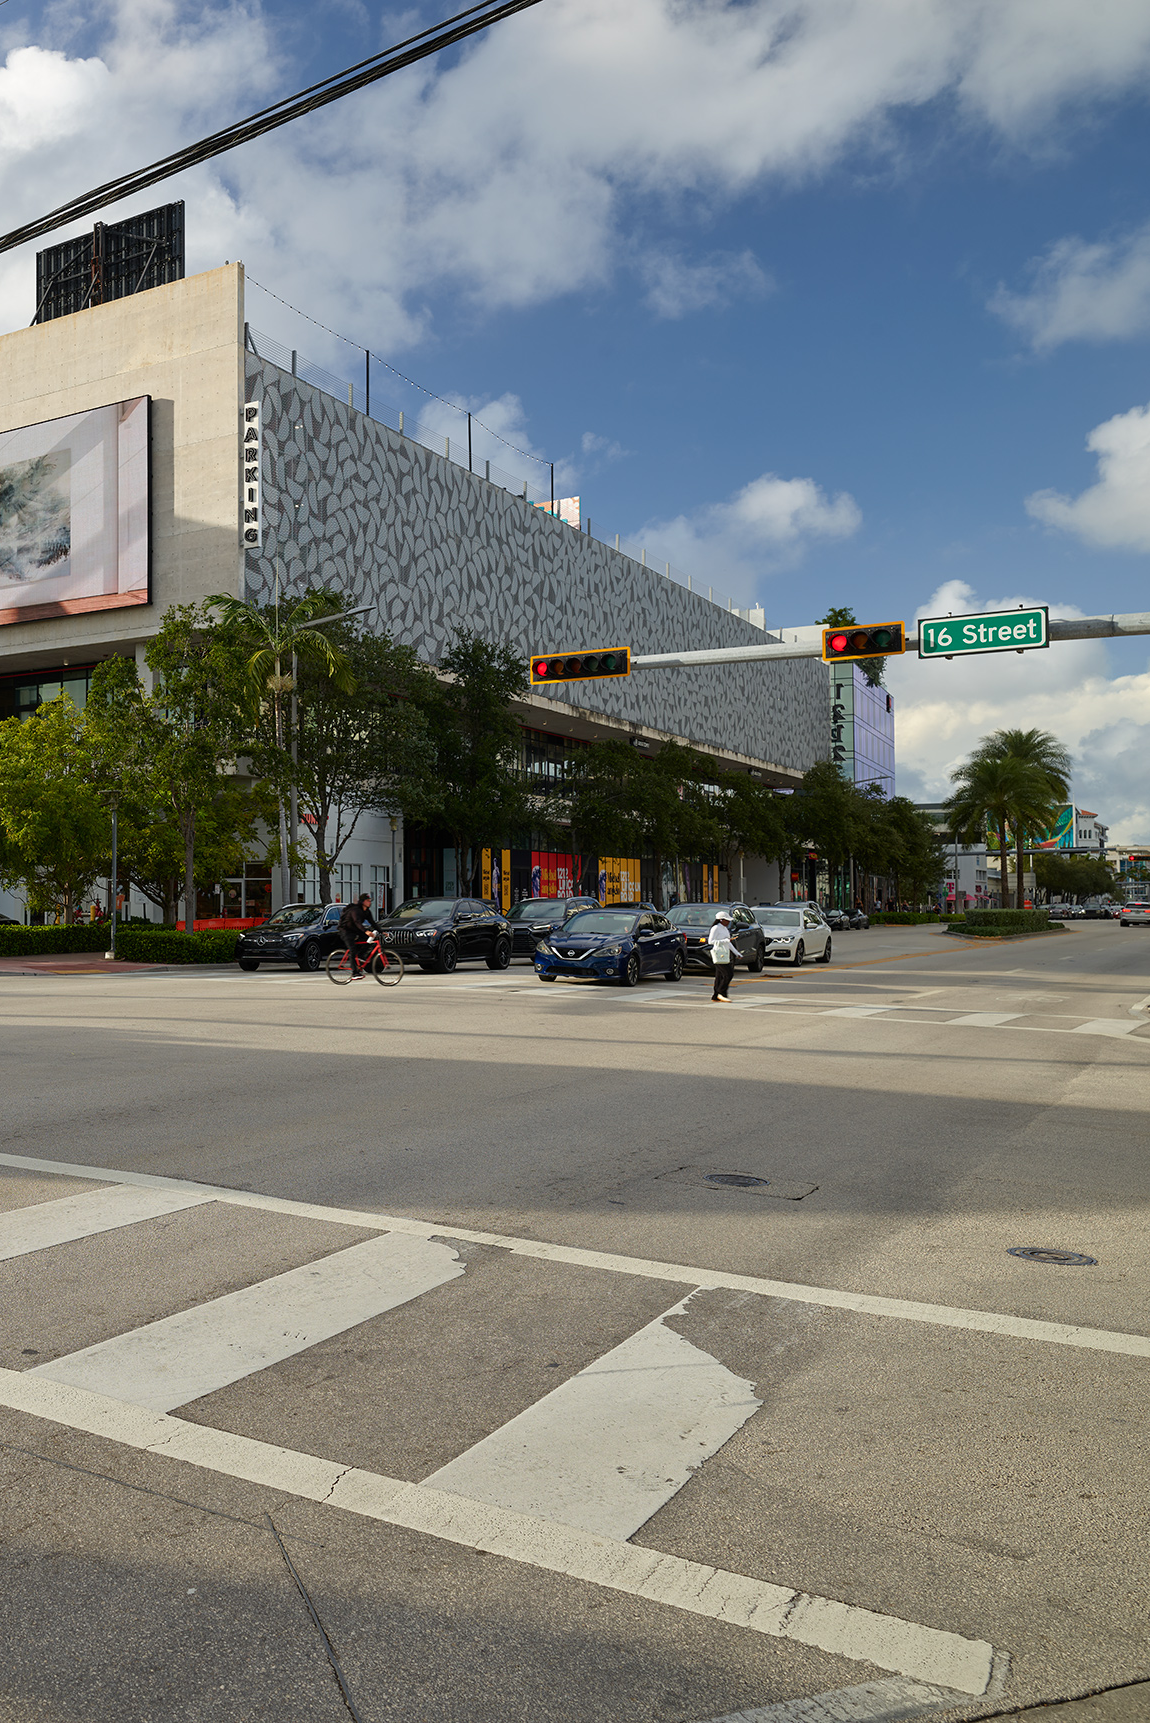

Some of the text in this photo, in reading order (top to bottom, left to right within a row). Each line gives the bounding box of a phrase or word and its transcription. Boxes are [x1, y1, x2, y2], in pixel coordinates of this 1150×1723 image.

[244, 407, 258, 543] PARKING
[928, 618, 1037, 648] 16 Street
[557, 868, 568, 879] 1212
[946, 882, 954, 892] T
